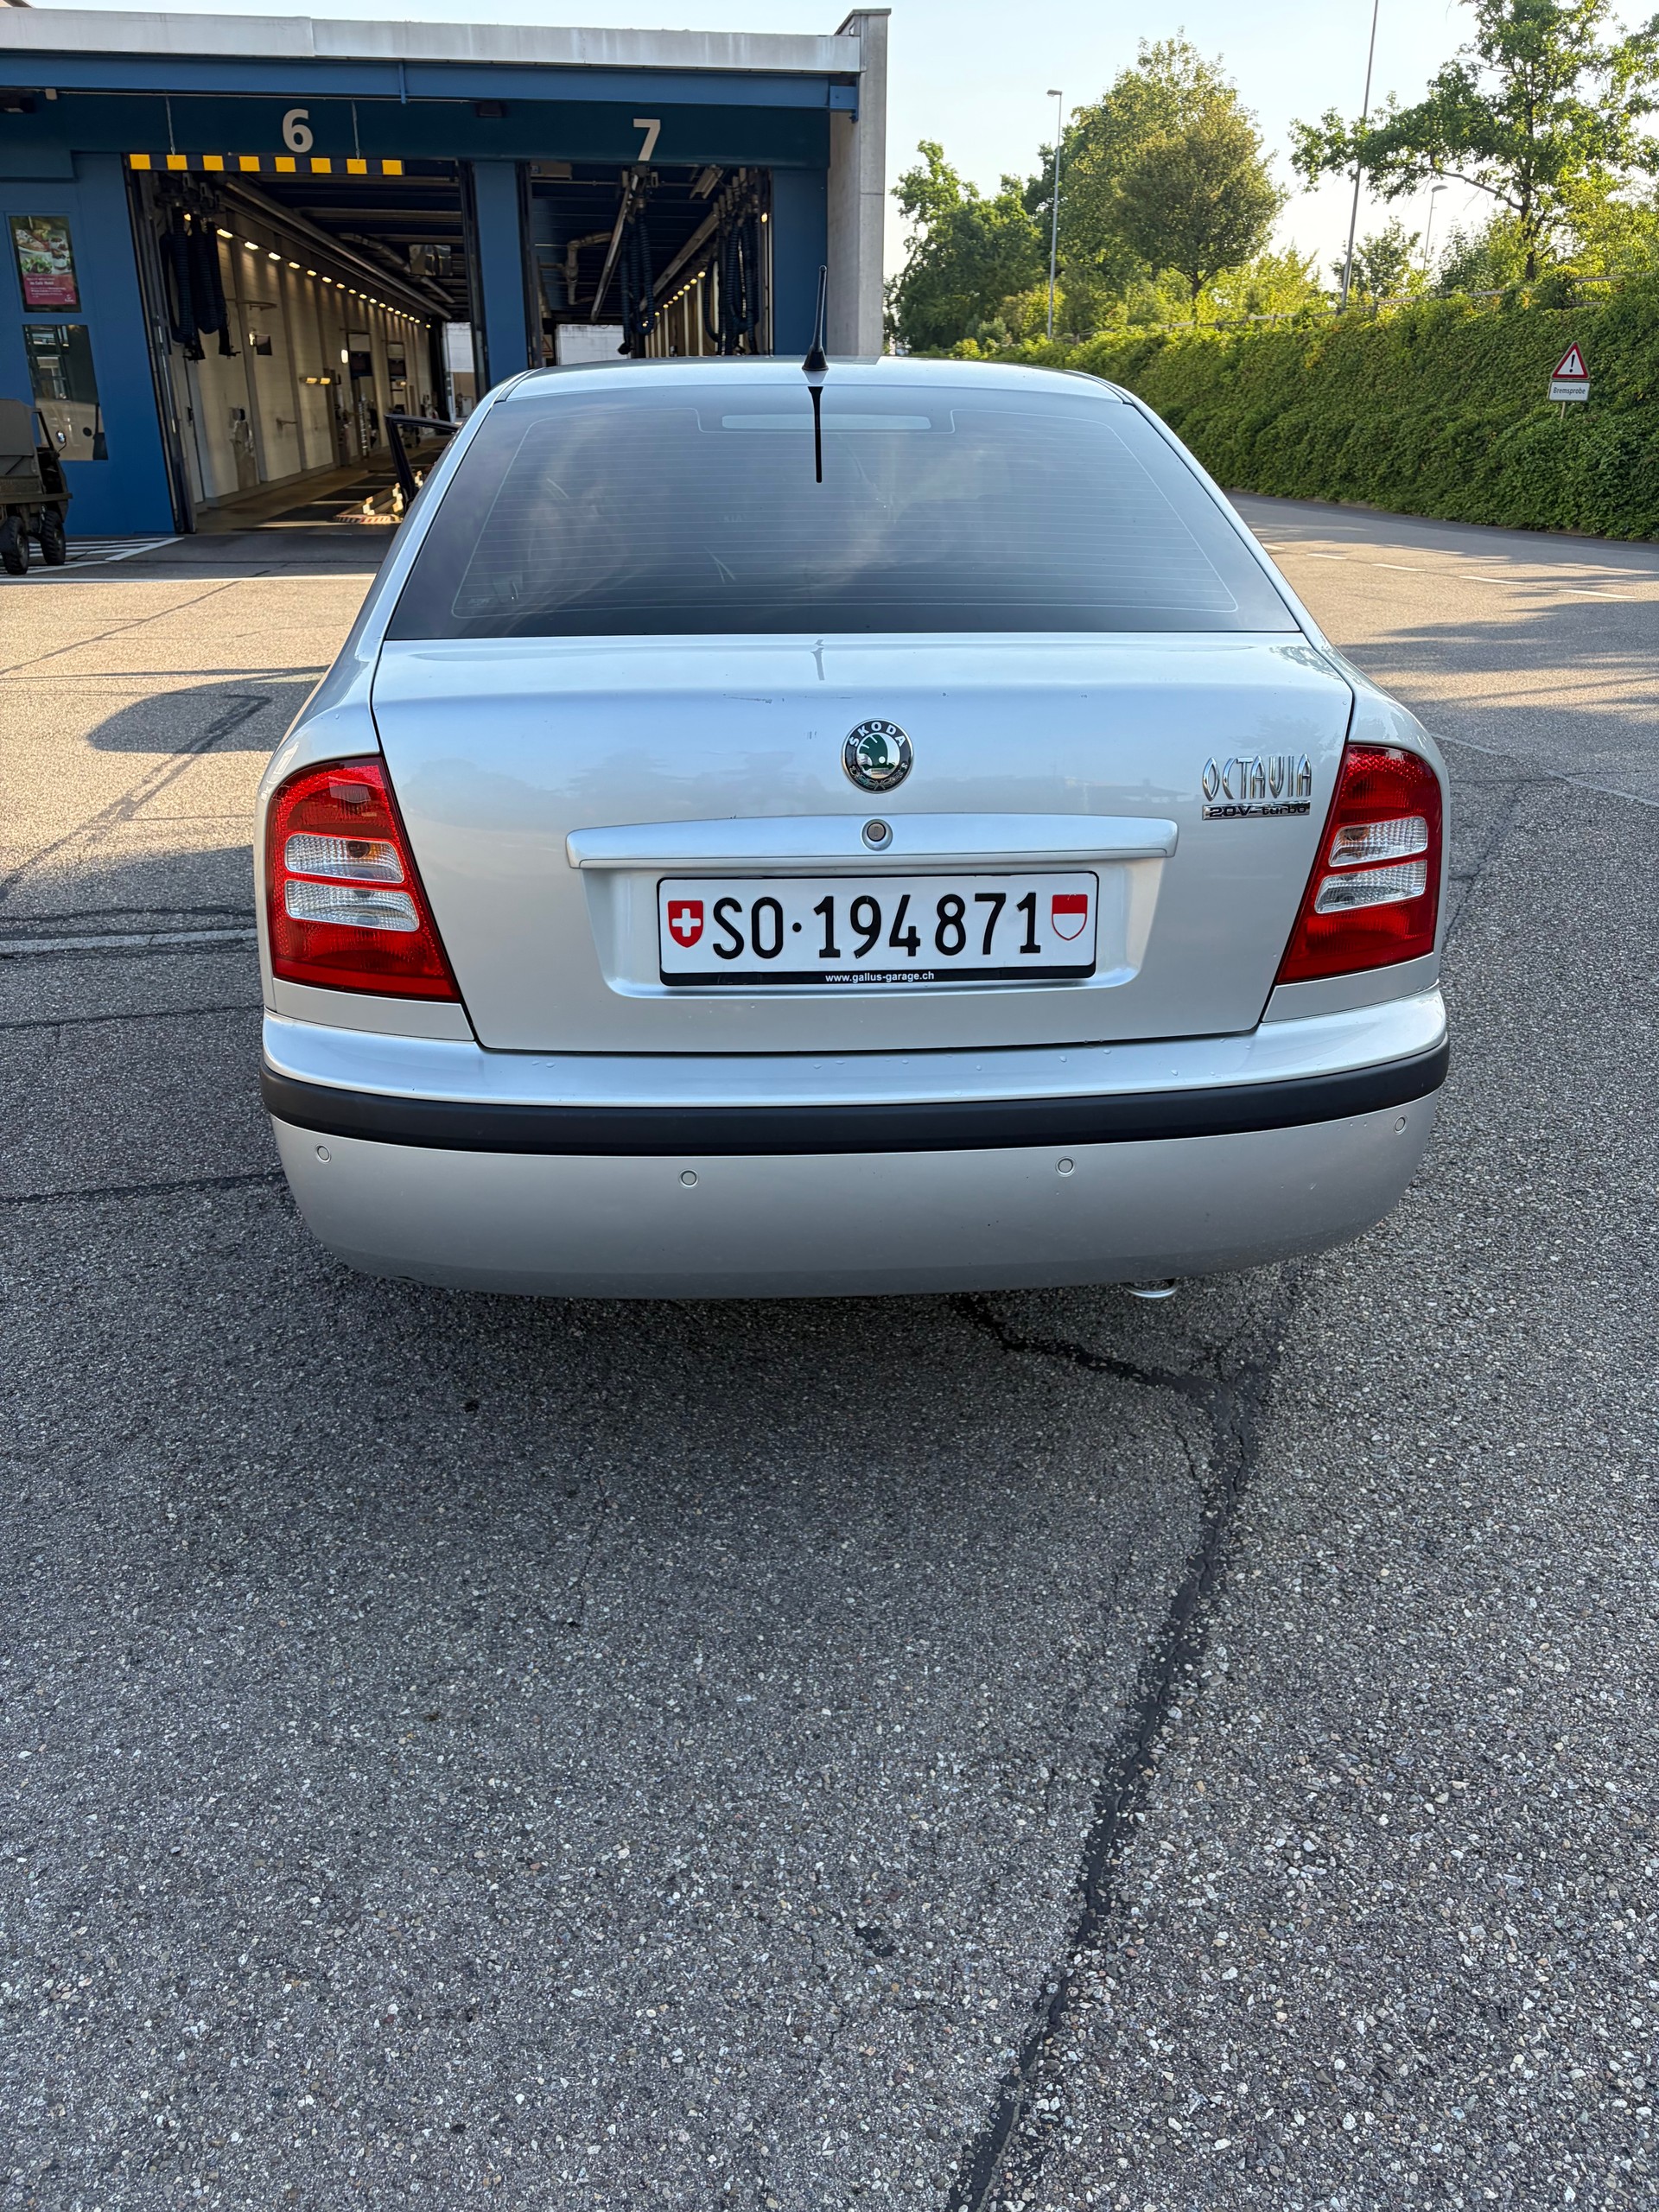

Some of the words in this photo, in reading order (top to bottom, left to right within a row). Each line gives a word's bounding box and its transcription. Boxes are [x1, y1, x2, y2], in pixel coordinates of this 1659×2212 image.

[283, 108, 314, 153] 6
[632, 118, 661, 161] 7
[1203, 753, 1313, 802] OCTAVIA
[825, 971, 935, 983] www.gallus-garage.ch
